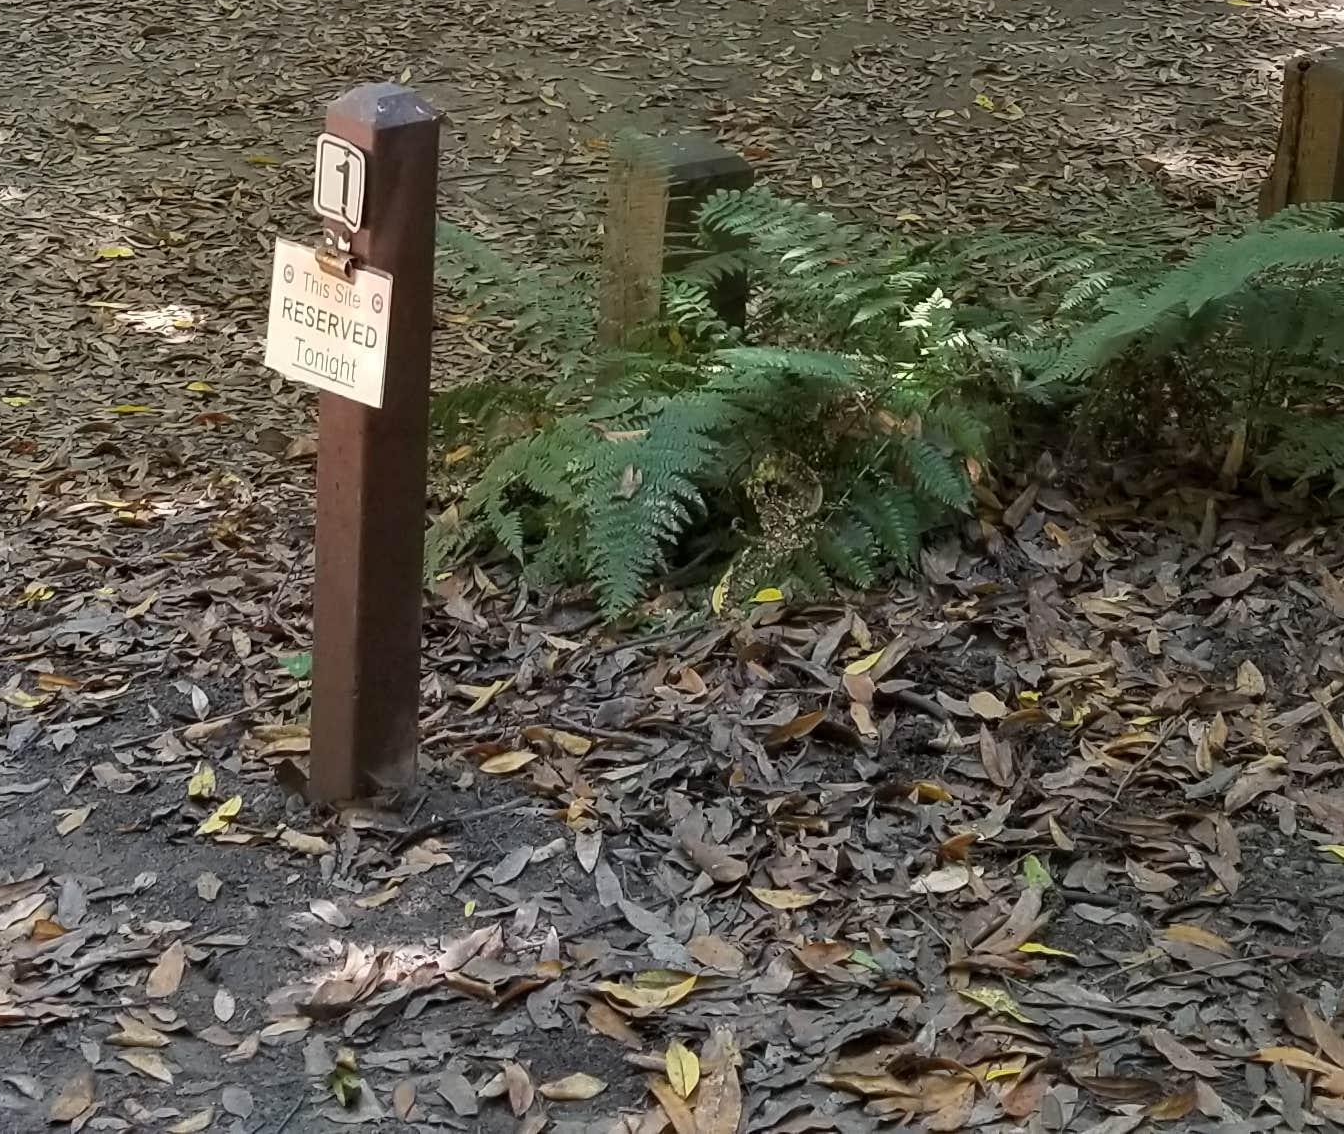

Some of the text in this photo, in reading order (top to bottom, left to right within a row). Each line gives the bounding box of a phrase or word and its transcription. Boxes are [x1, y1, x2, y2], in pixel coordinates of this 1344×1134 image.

[336, 160, 350, 206] 1
[303, 271, 361, 309] This Site
[282, 297, 377, 349] RESERVED
[294, 337, 357, 383] Tonight
